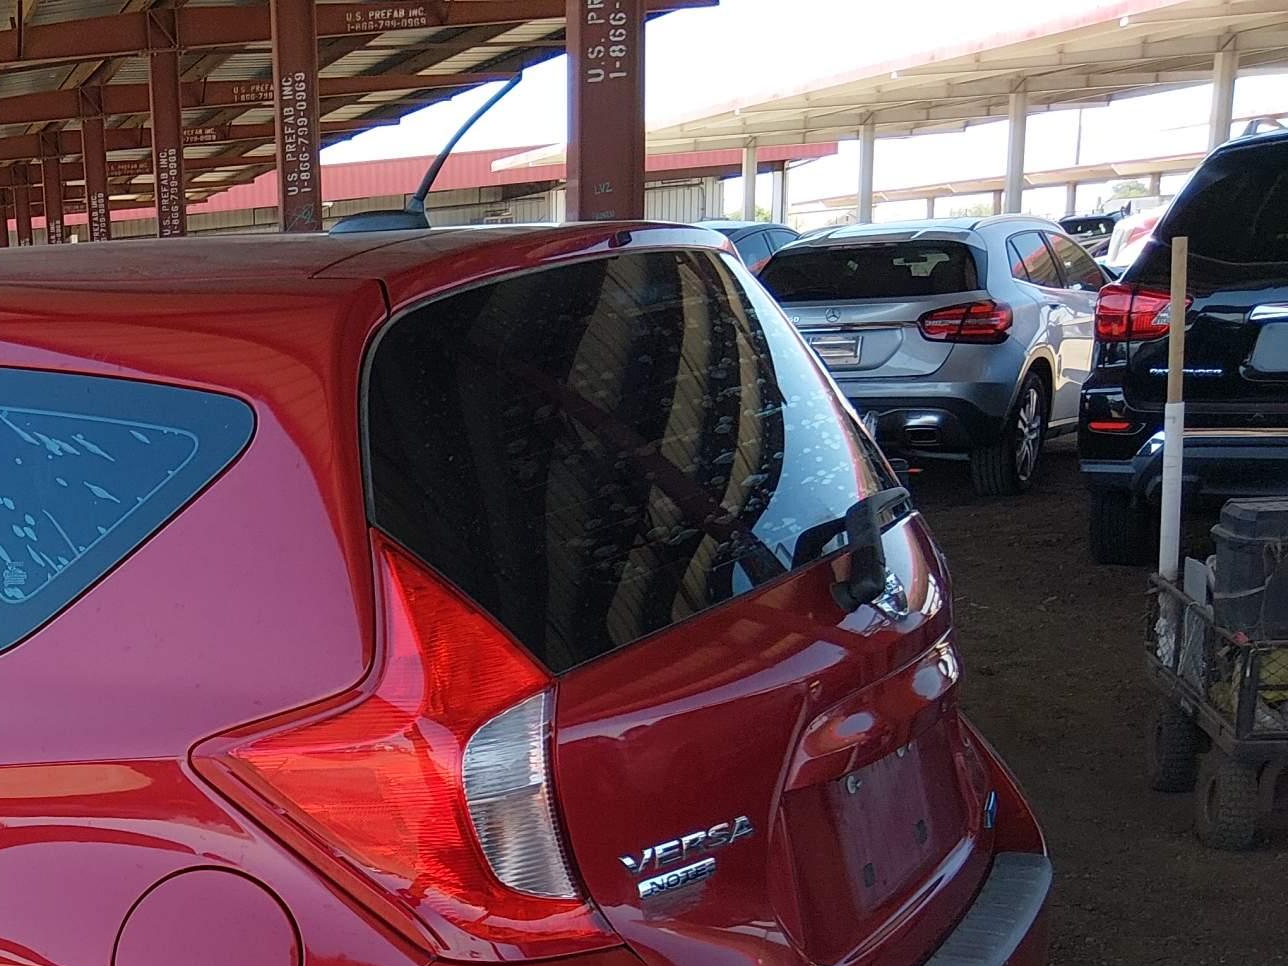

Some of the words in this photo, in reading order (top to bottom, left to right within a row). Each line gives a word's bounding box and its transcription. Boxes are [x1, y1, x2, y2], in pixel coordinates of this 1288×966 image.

[368, 8, 405, 20] PREFAB
[587, 38, 605, 82] U.S.
[281, 72, 293, 99] INC.
[284, 107, 297, 161] PREFAB
[295, 72, 312, 192] 1-866-799-0969
[160, 173, 169, 211] PREFAB
[287, 169, 299, 195] U.S.
[617, 815, 753, 875] VERSA
[649, 861, 715, 894] NOTE
